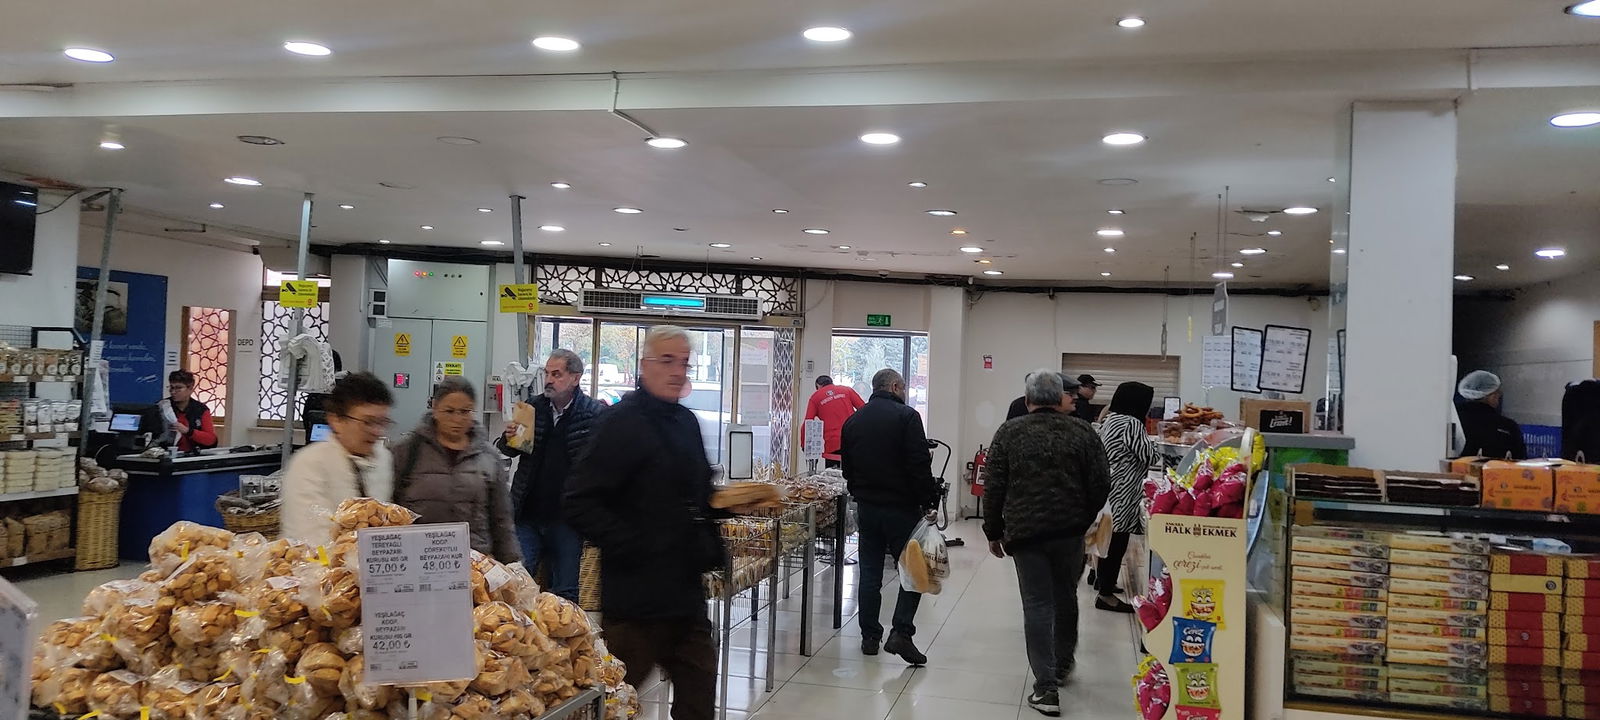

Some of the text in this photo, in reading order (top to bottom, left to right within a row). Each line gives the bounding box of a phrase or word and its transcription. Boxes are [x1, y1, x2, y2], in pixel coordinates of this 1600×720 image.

[237, 338, 254, 346] DEPO
[1165, 526, 1237, 538] HALK EKMEK
[369, 563, 398, 574] 57,00
[423, 560, 451, 571] 48,00
[1173, 559, 1202, 573] çerezi
[372, 640, 402, 651] 42,00
